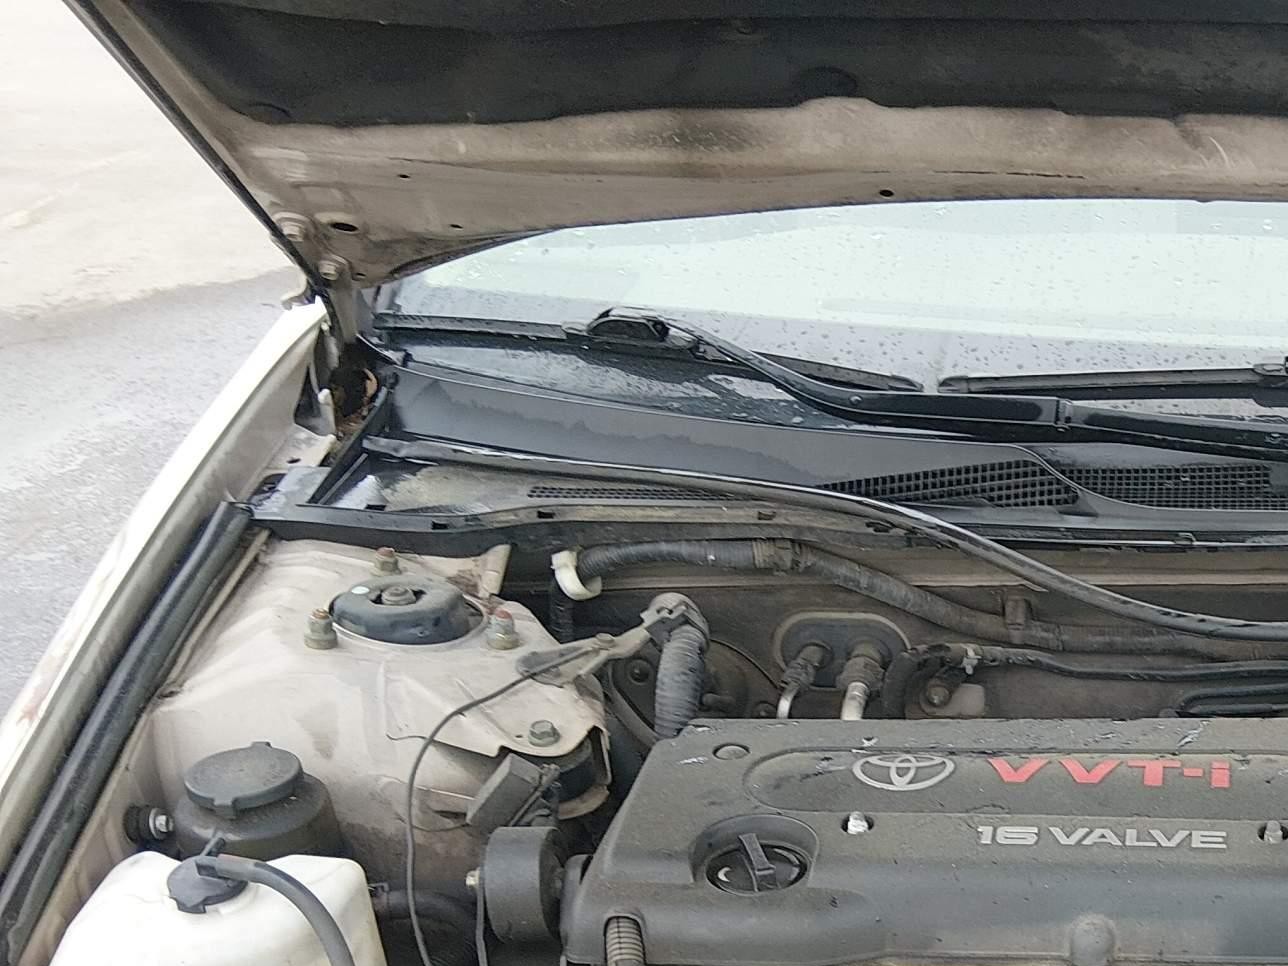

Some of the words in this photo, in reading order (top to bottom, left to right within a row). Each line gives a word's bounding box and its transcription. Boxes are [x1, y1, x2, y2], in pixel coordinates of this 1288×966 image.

[986, 757, 1231, 789] VVT-i
[977, 825, 1039, 846] 16
[1049, 826, 1228, 850] VALVE
